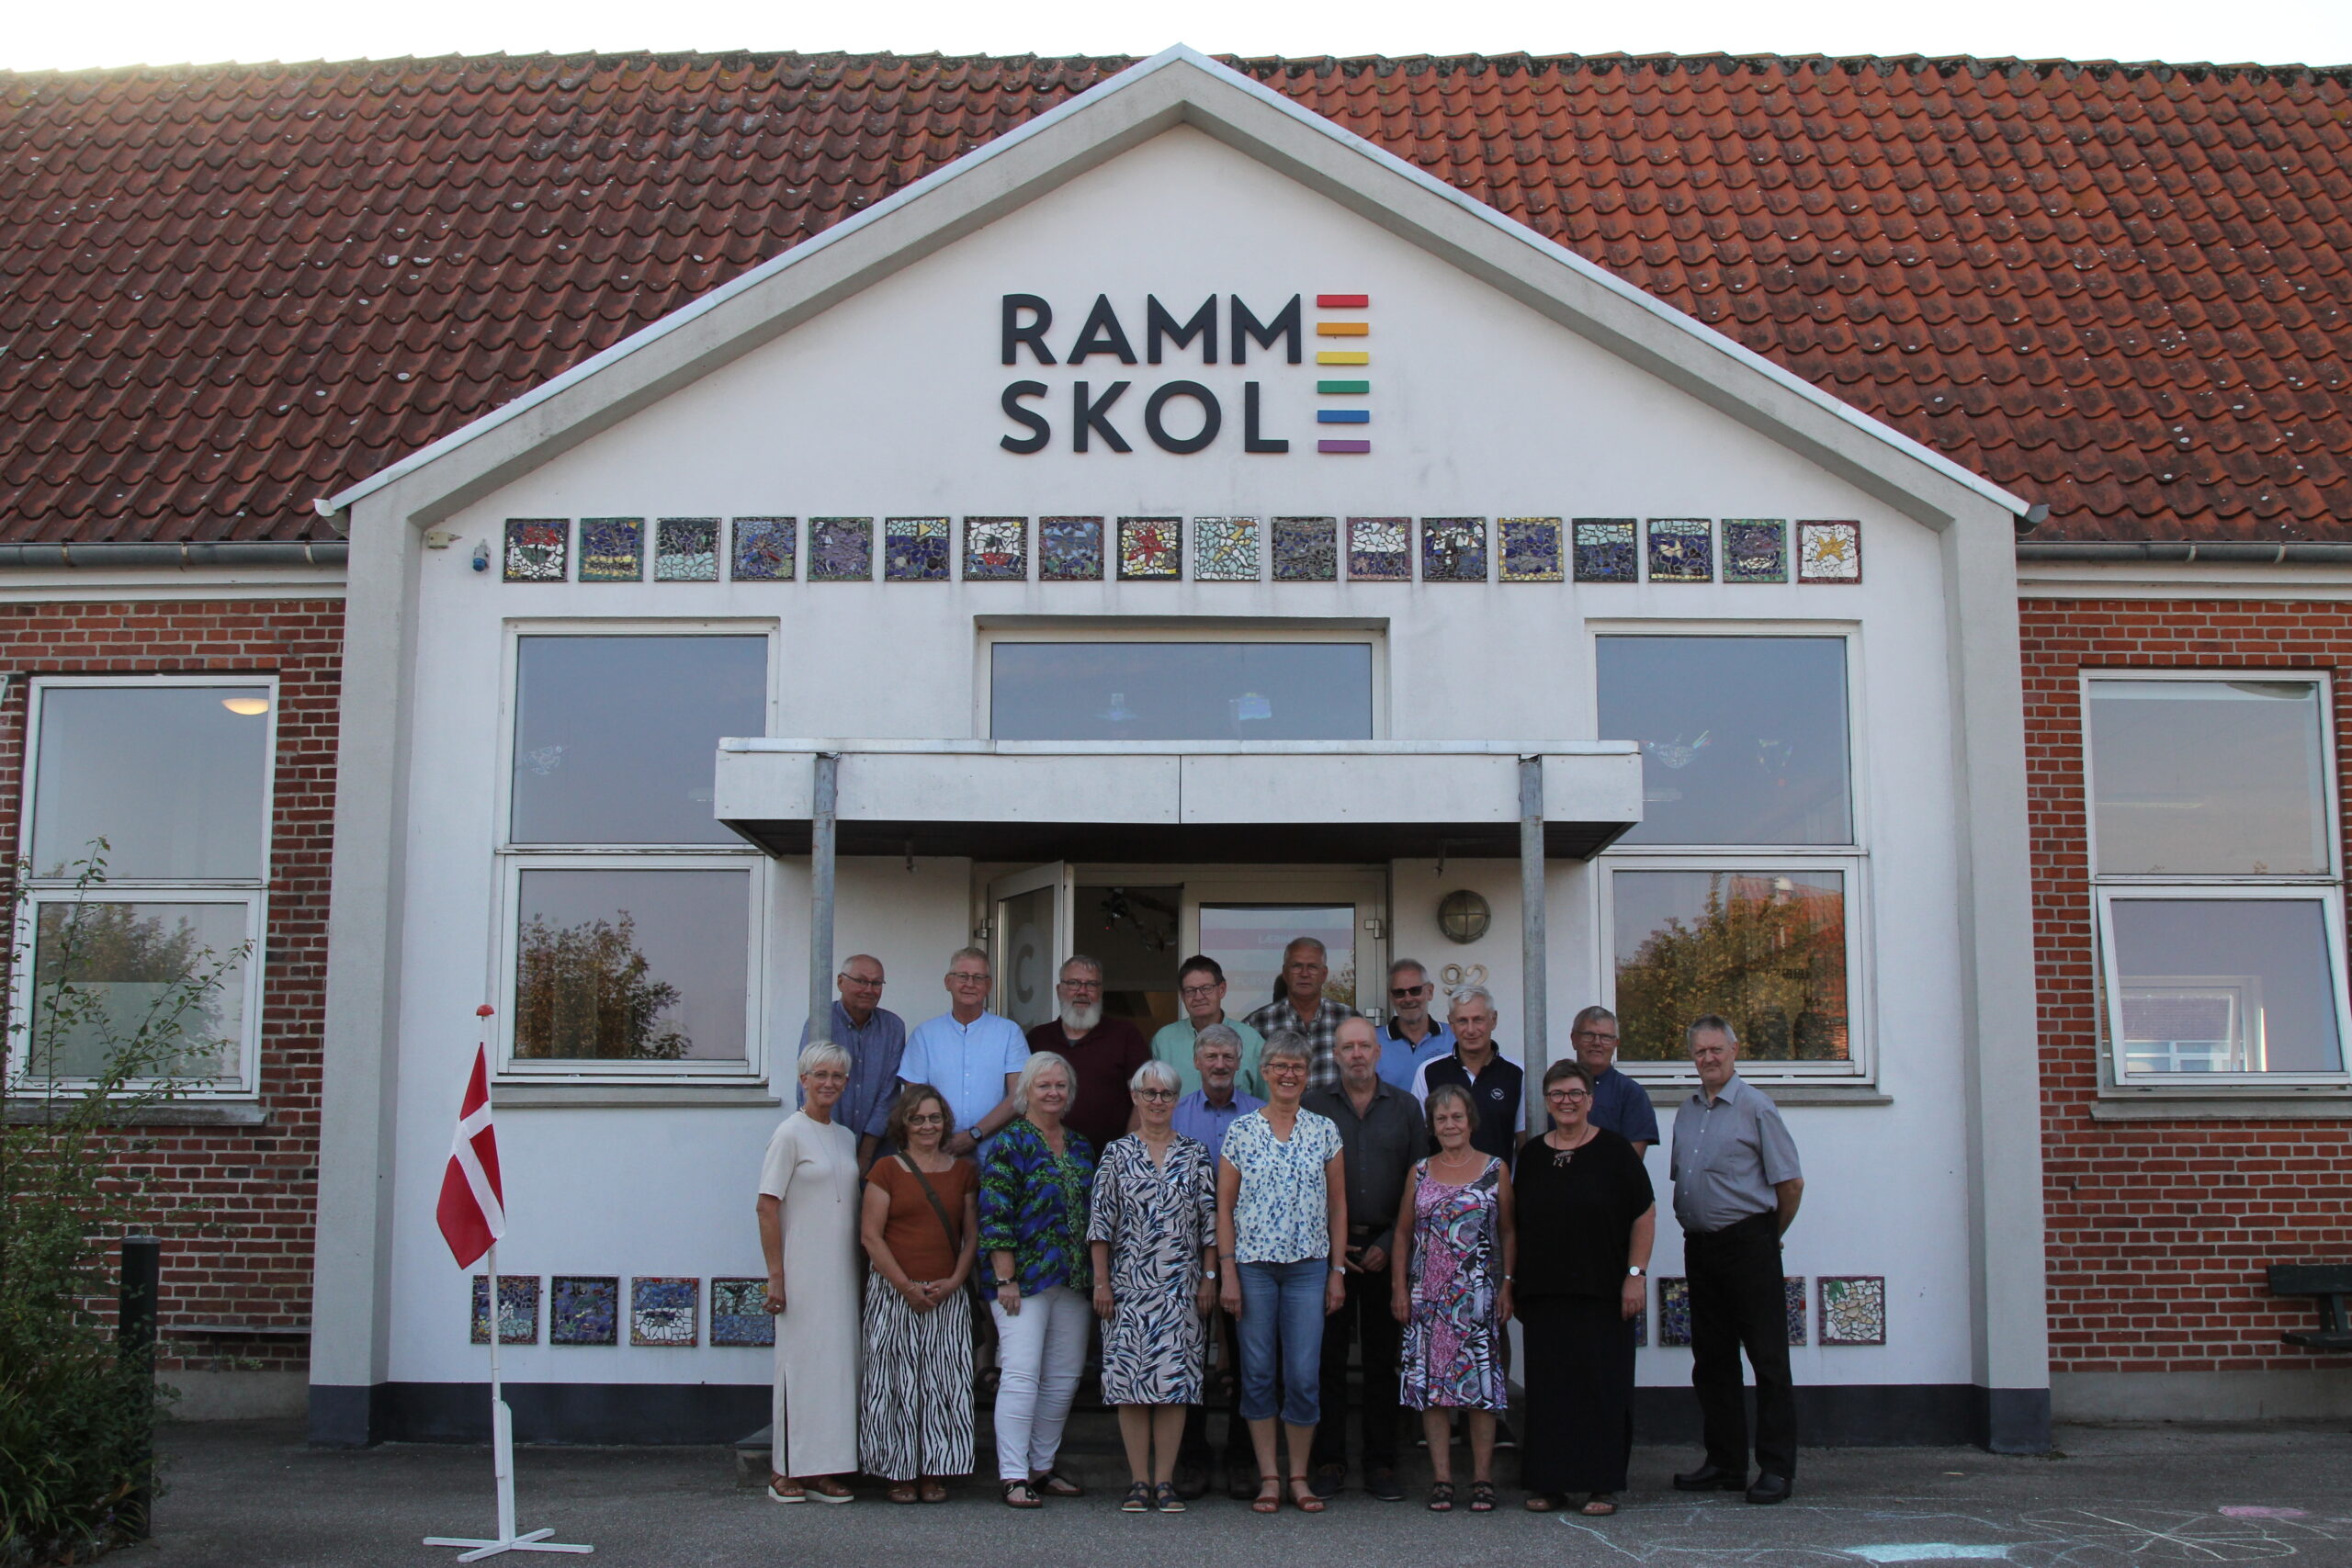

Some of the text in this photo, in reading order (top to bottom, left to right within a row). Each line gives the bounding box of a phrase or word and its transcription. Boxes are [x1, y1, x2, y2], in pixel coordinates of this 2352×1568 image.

[1001, 293, 1370, 366] RAMME
[1000, 379, 1371, 455] SKOLE
[1442, 964, 1488, 996] 92
